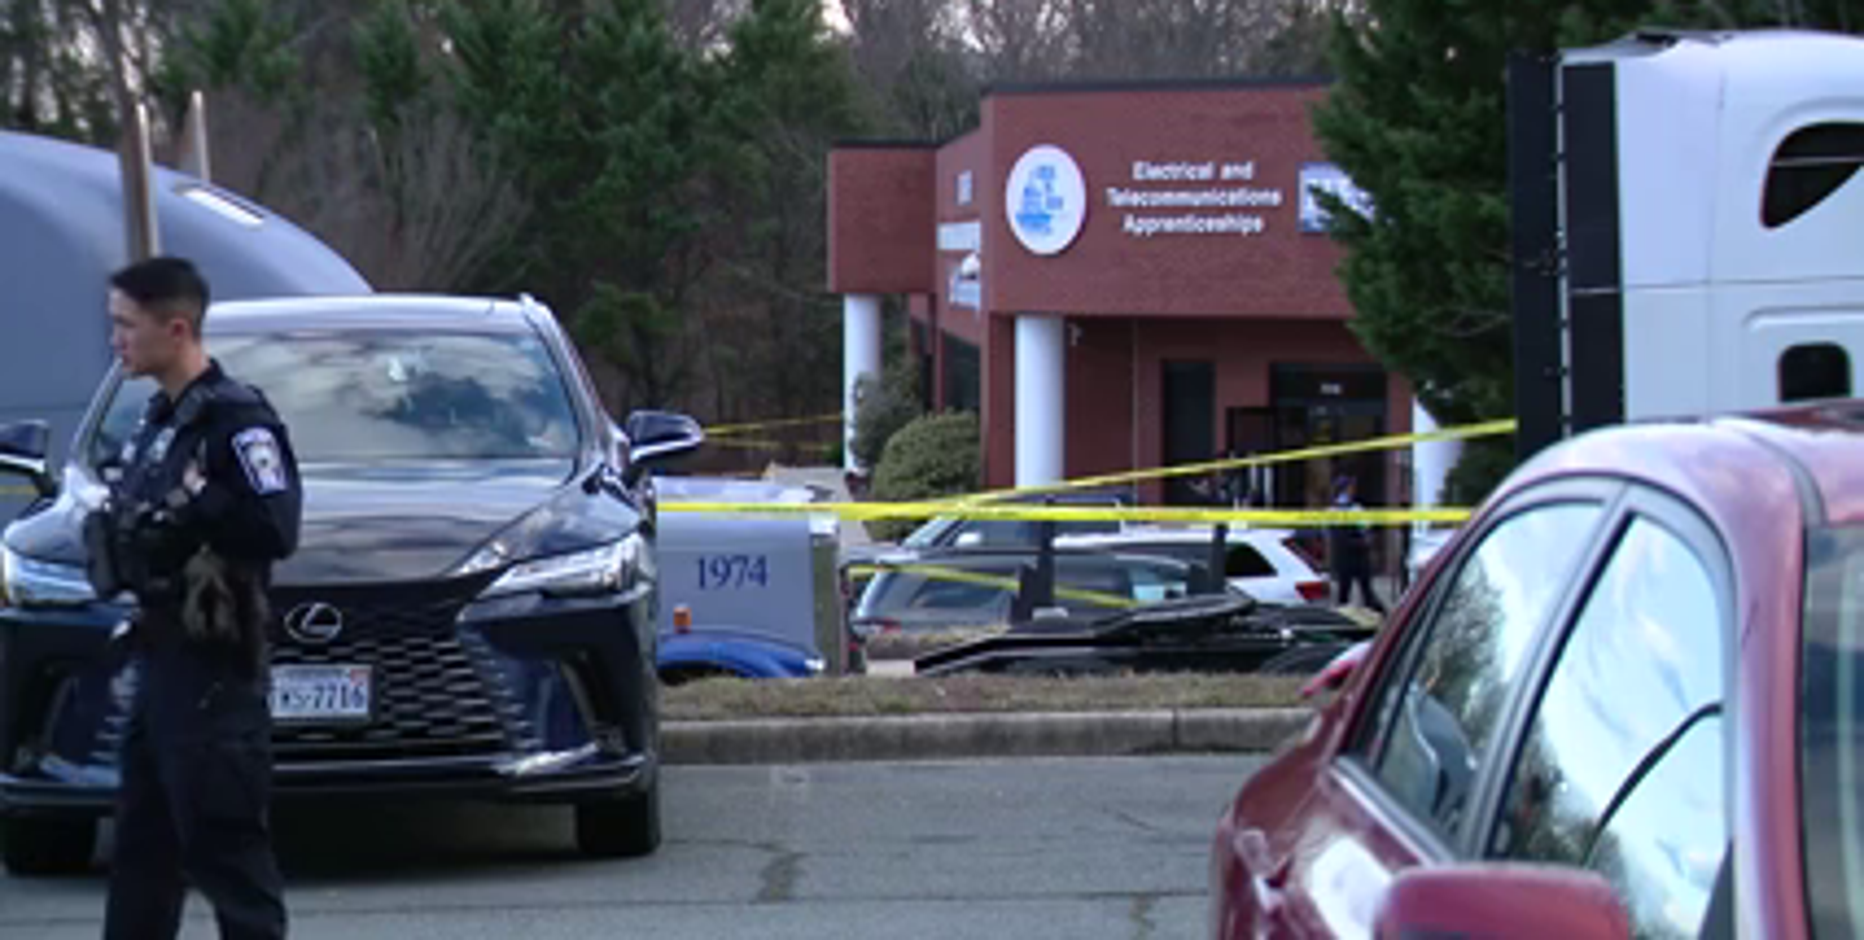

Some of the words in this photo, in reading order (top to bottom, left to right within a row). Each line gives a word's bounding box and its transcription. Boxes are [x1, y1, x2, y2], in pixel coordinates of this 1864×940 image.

[1132, 161, 1214, 181] Electrical
[1220, 161, 1254, 181] and
[1106, 187, 1283, 207] Telecommunications
[1123, 214, 1265, 236] Apprenticeships
[698, 554, 767, 590] 1974
